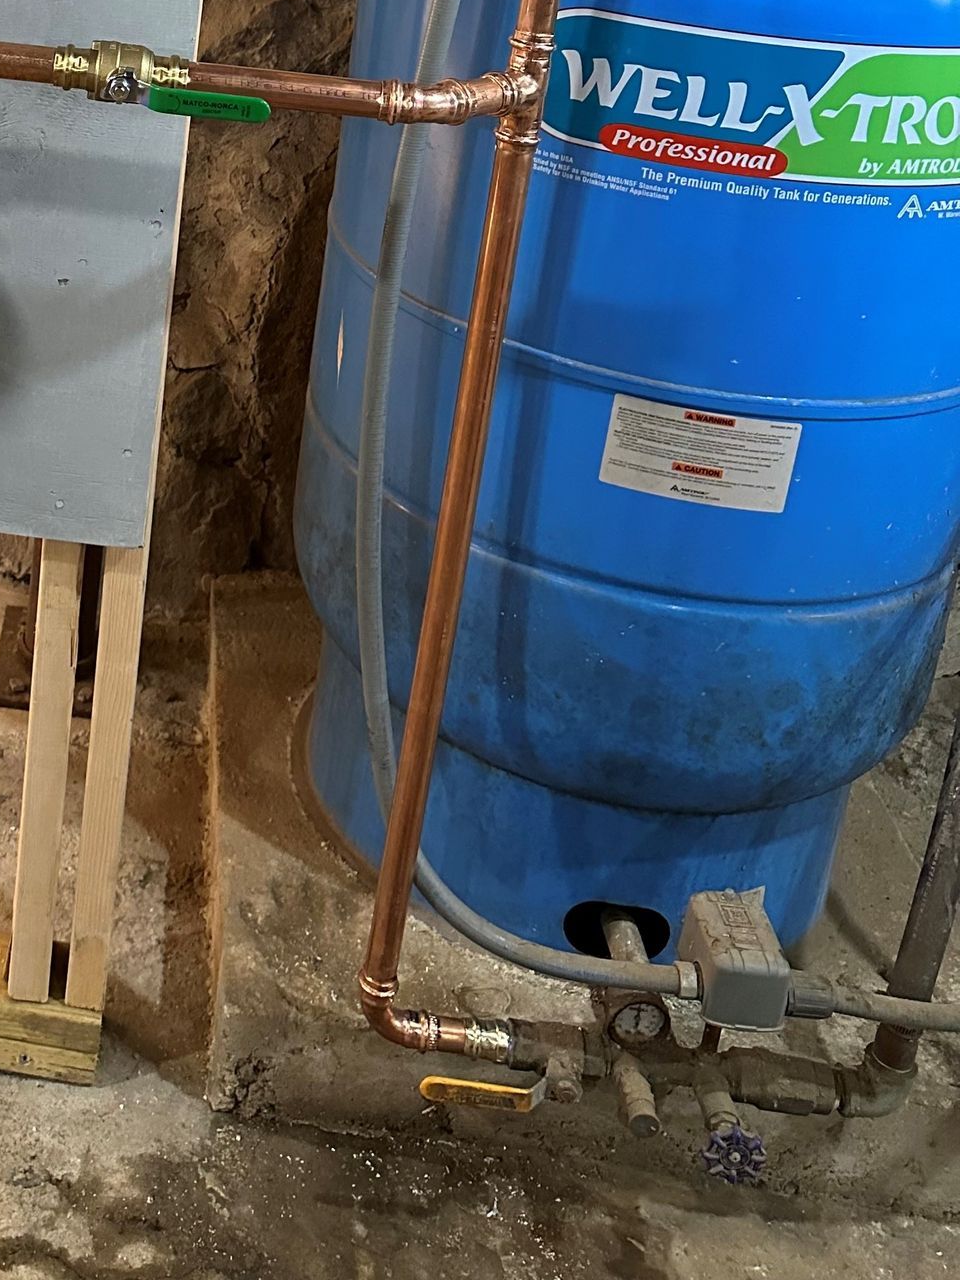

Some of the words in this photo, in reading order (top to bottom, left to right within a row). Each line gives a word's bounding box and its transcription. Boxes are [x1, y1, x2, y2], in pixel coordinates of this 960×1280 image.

[182, 100, 240, 111] MATCO-NORCA
[550, 152, 559, 160] the
[561, 155, 574, 163] USA
[612, 129, 777, 171] Professional
[858, 158, 883, 178] by
[558, 164, 570, 172] NSF
[580, 169, 606, 181] meeting
[639, 182, 668, 193] Standard
[562, 172, 574, 180] Use
[582, 177, 609, 189] Drinking
[610, 183, 629, 193] Water
[629, 187, 670, 200] Applications
[641, 167, 663, 182] The
[667, 171, 723, 192] Premium
[726, 182, 770, 200] Quality
[773, 187, 800, 202] Tank
[803, 190, 820, 203] for
[822, 192, 893, 207] Generations.
[695, 414, 735, 427] WARNING
[683, 465, 721, 478] CAUTION
